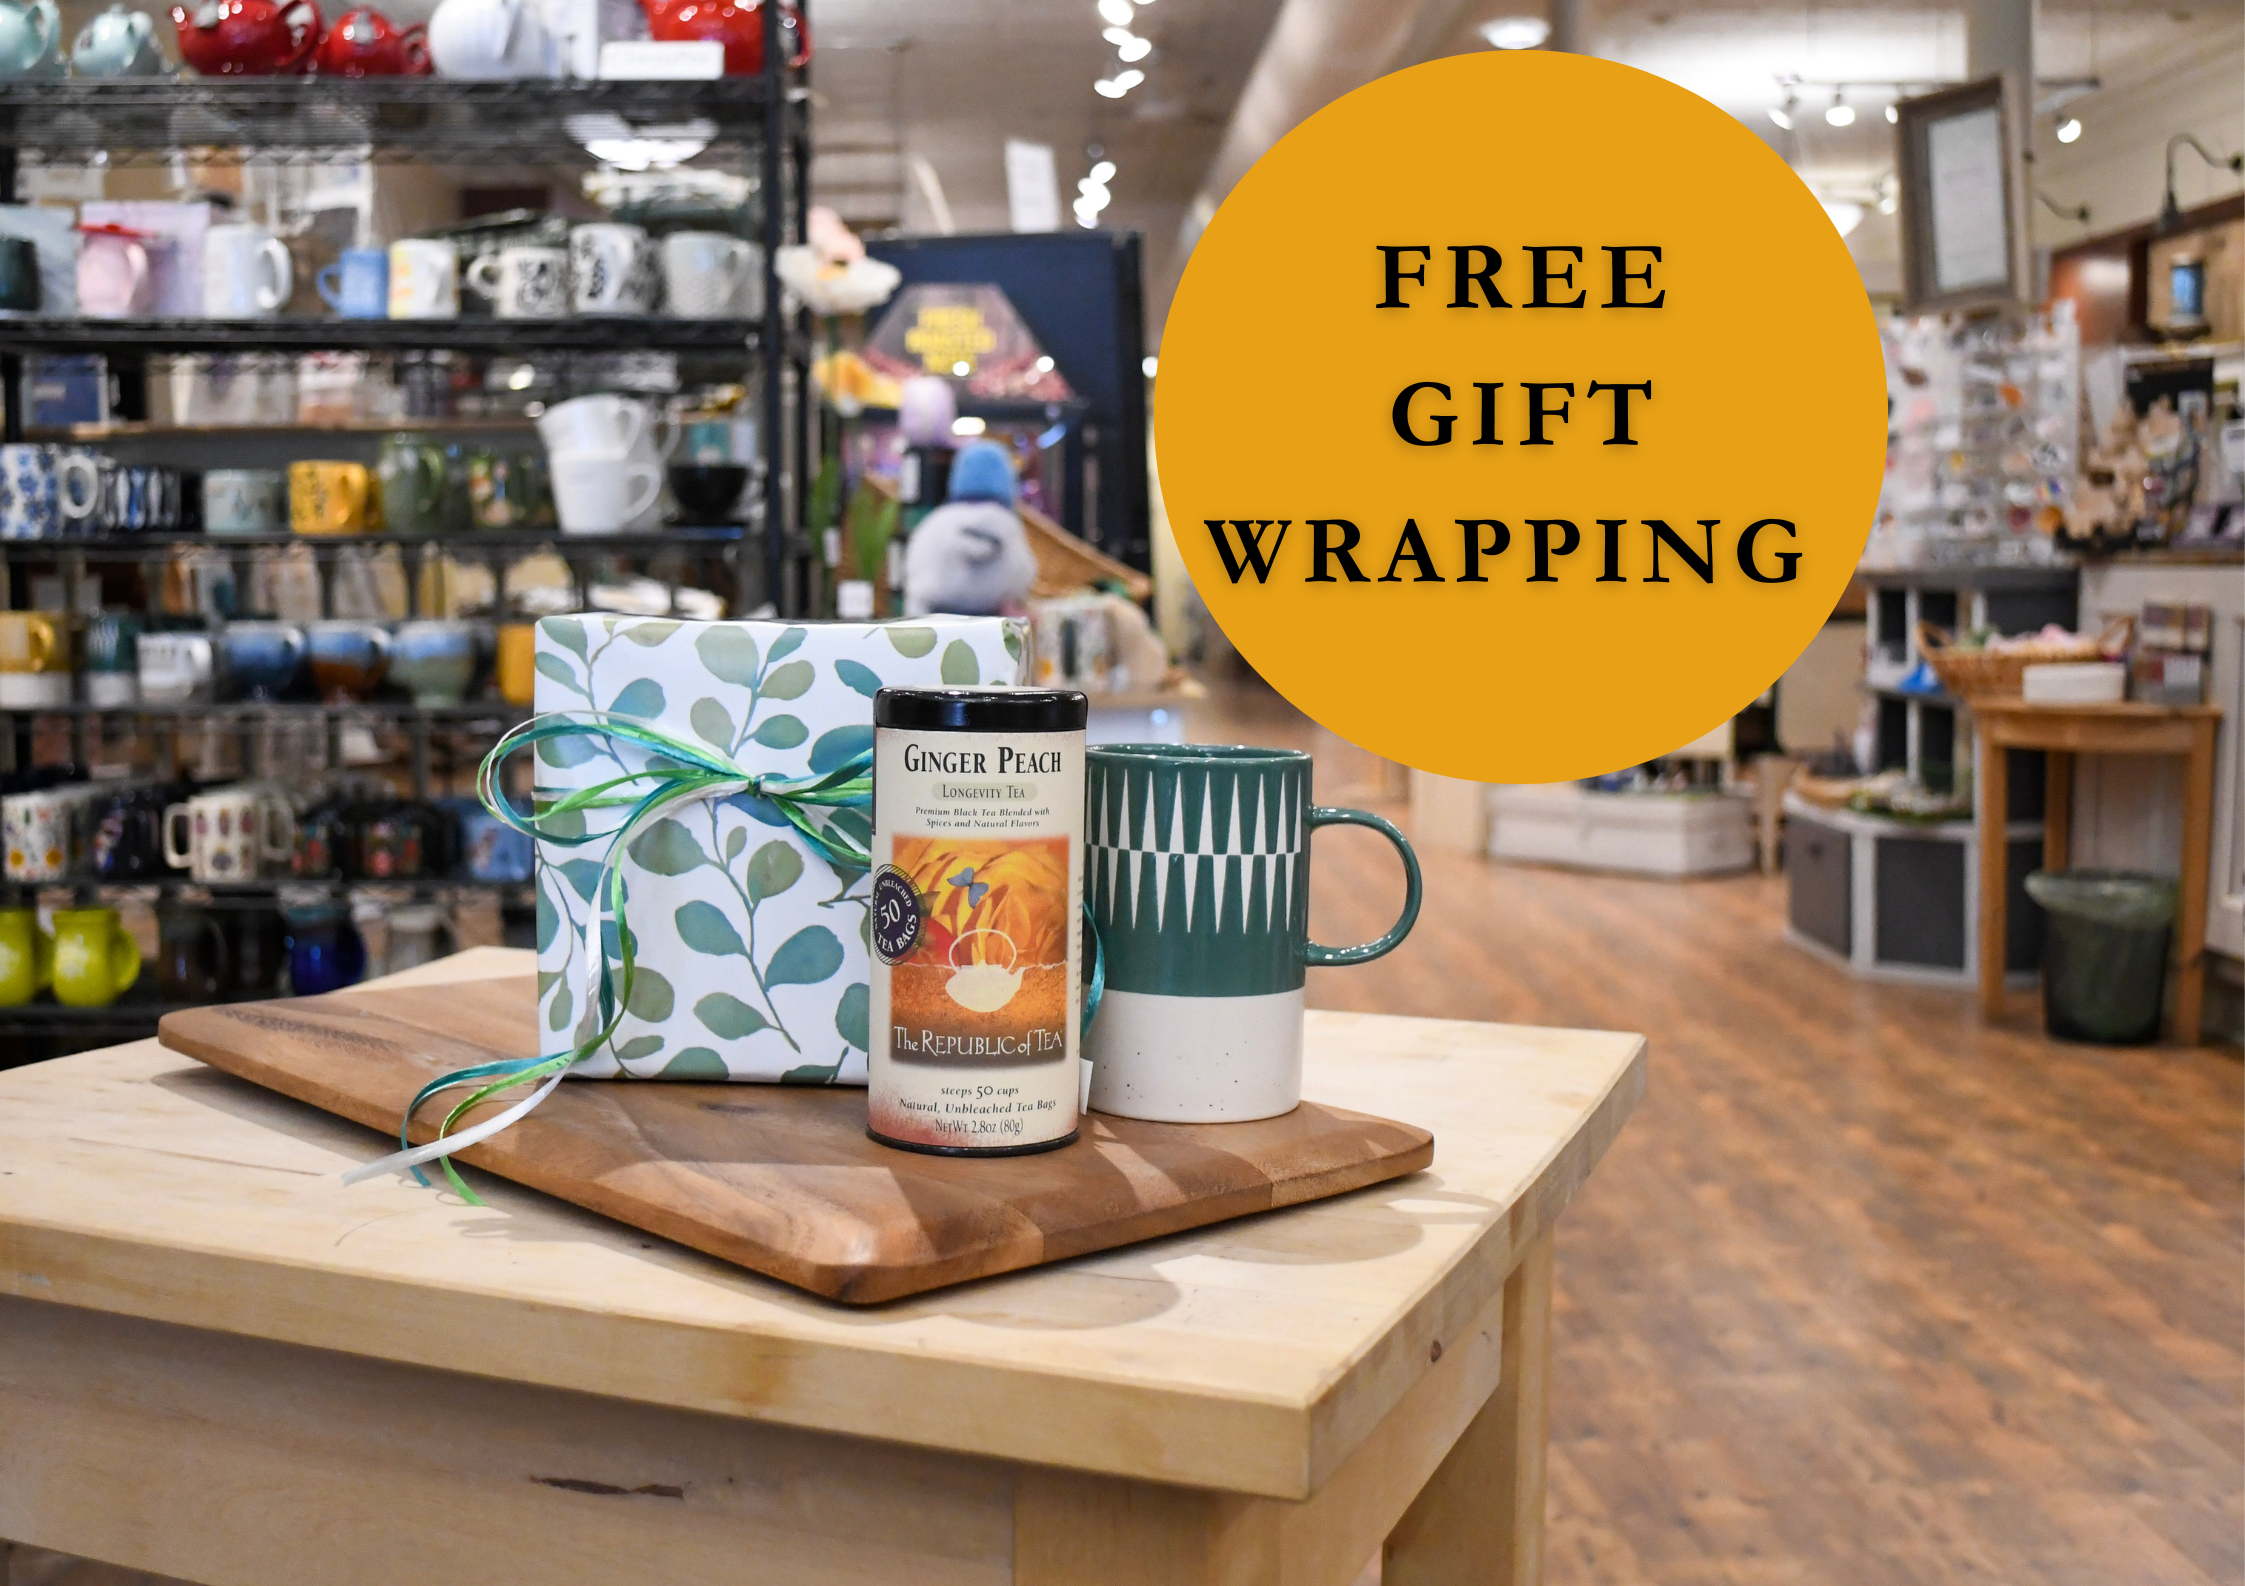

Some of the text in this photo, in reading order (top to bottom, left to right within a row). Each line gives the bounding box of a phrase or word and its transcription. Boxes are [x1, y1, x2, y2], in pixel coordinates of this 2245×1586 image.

[915, 806, 1050, 817] Premium Black Tea Blended with
[926, 818, 1040, 828] Spices and Natural Flavors
[879, 879, 912, 908] UNBLEACHED
[880, 898, 901, 930] 50
[877, 914, 917, 953] TEA BAGS
[893, 1026, 918, 1051] The
[1017, 1030, 1032, 1056] of
[941, 1086, 1020, 1100] steeps 50 cups
[900, 1098, 1057, 1114] Natural, Unbleached Tea Bags
[1000, 1117, 1025, 1136] (80g)
